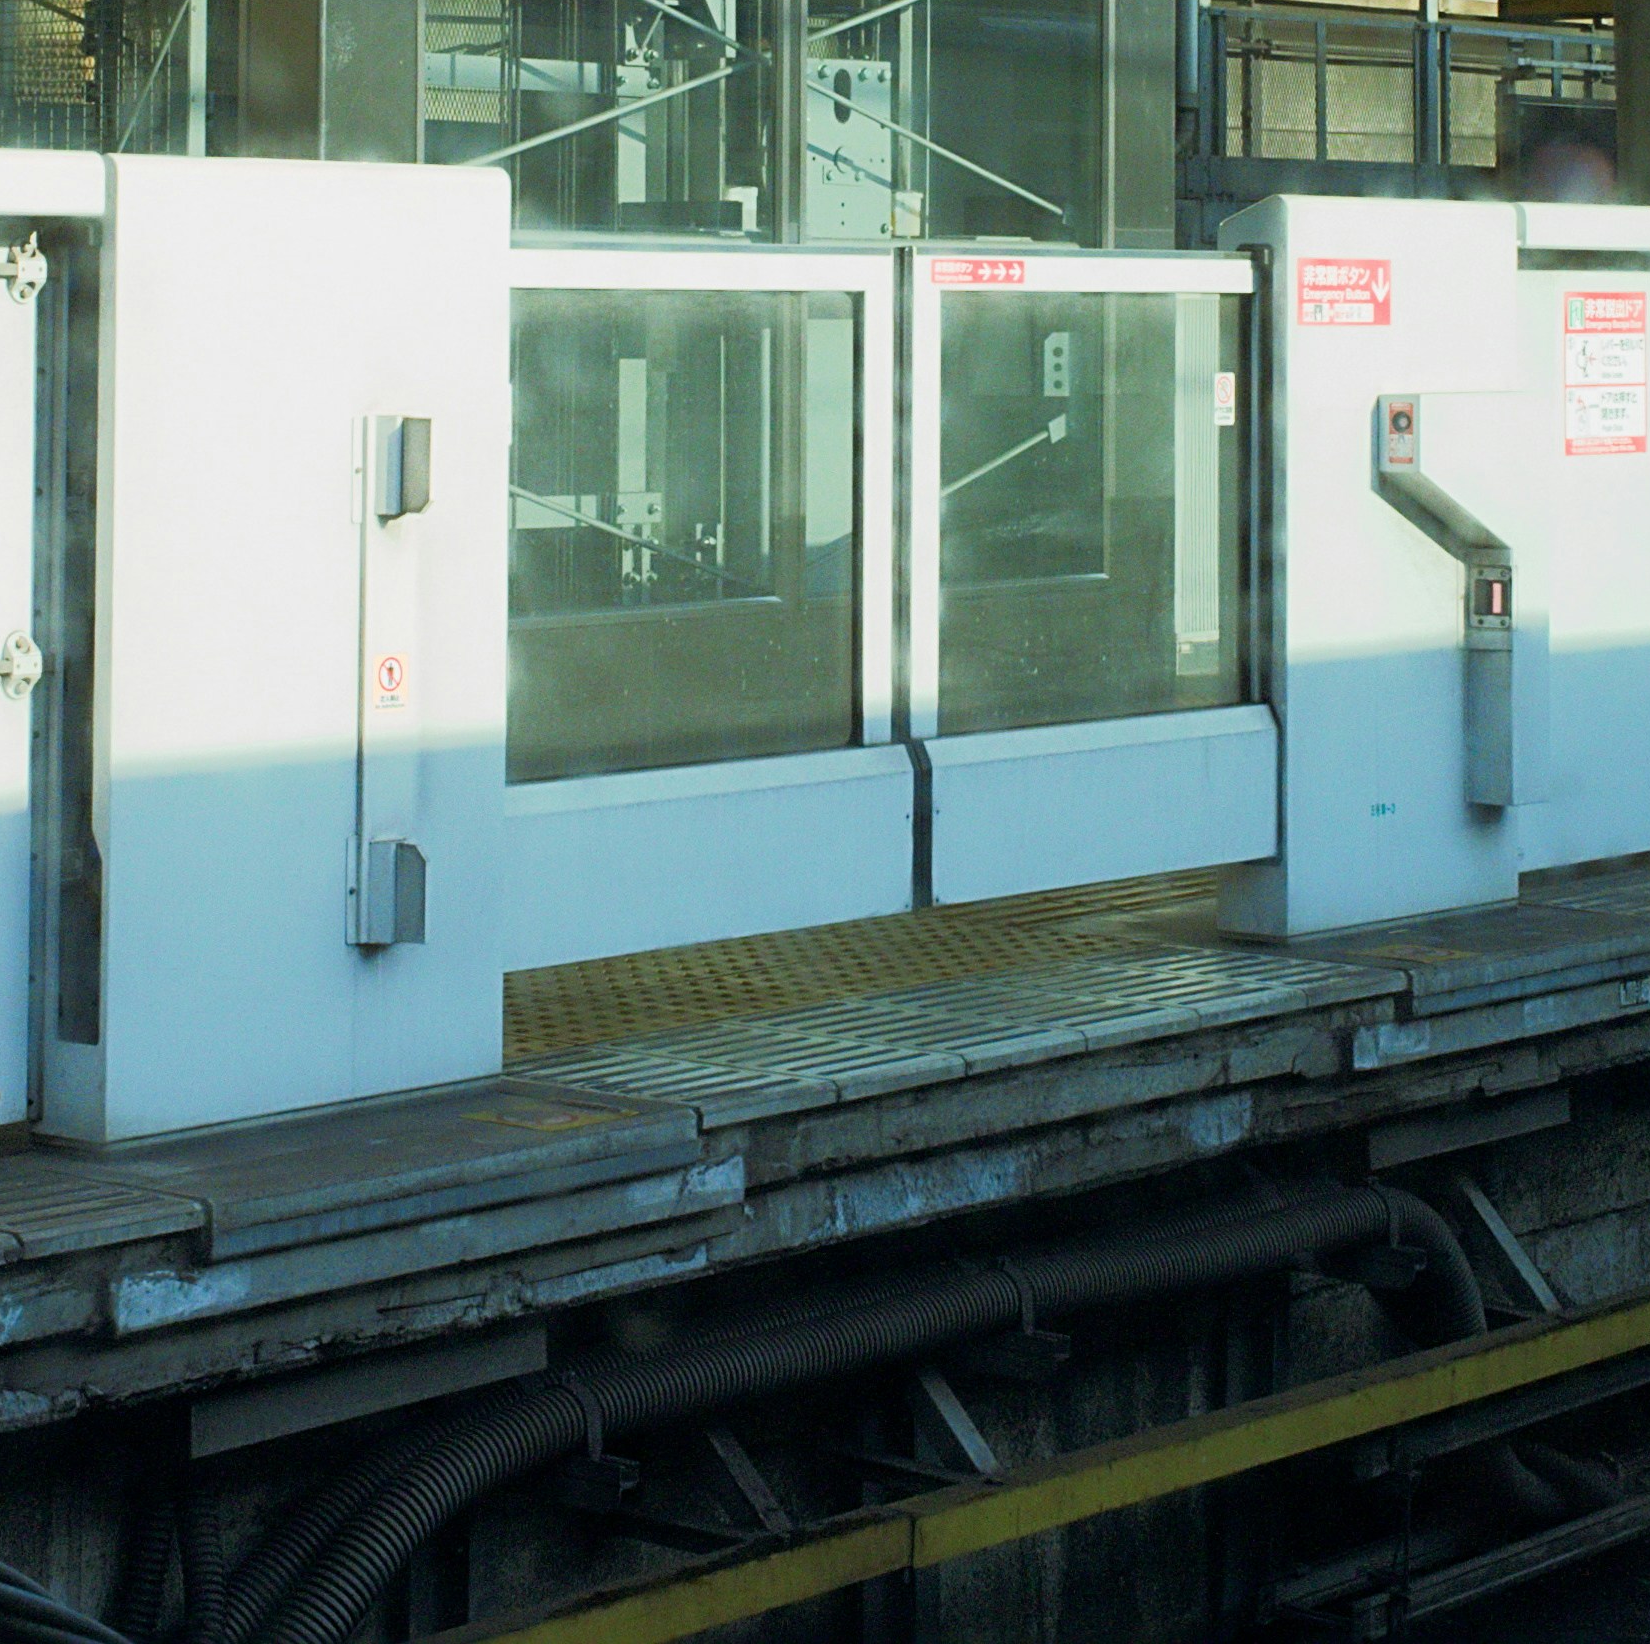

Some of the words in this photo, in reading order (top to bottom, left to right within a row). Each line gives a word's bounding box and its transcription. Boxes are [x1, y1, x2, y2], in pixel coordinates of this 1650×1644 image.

[1303, 264, 1370, 286] 非常開ボタン
